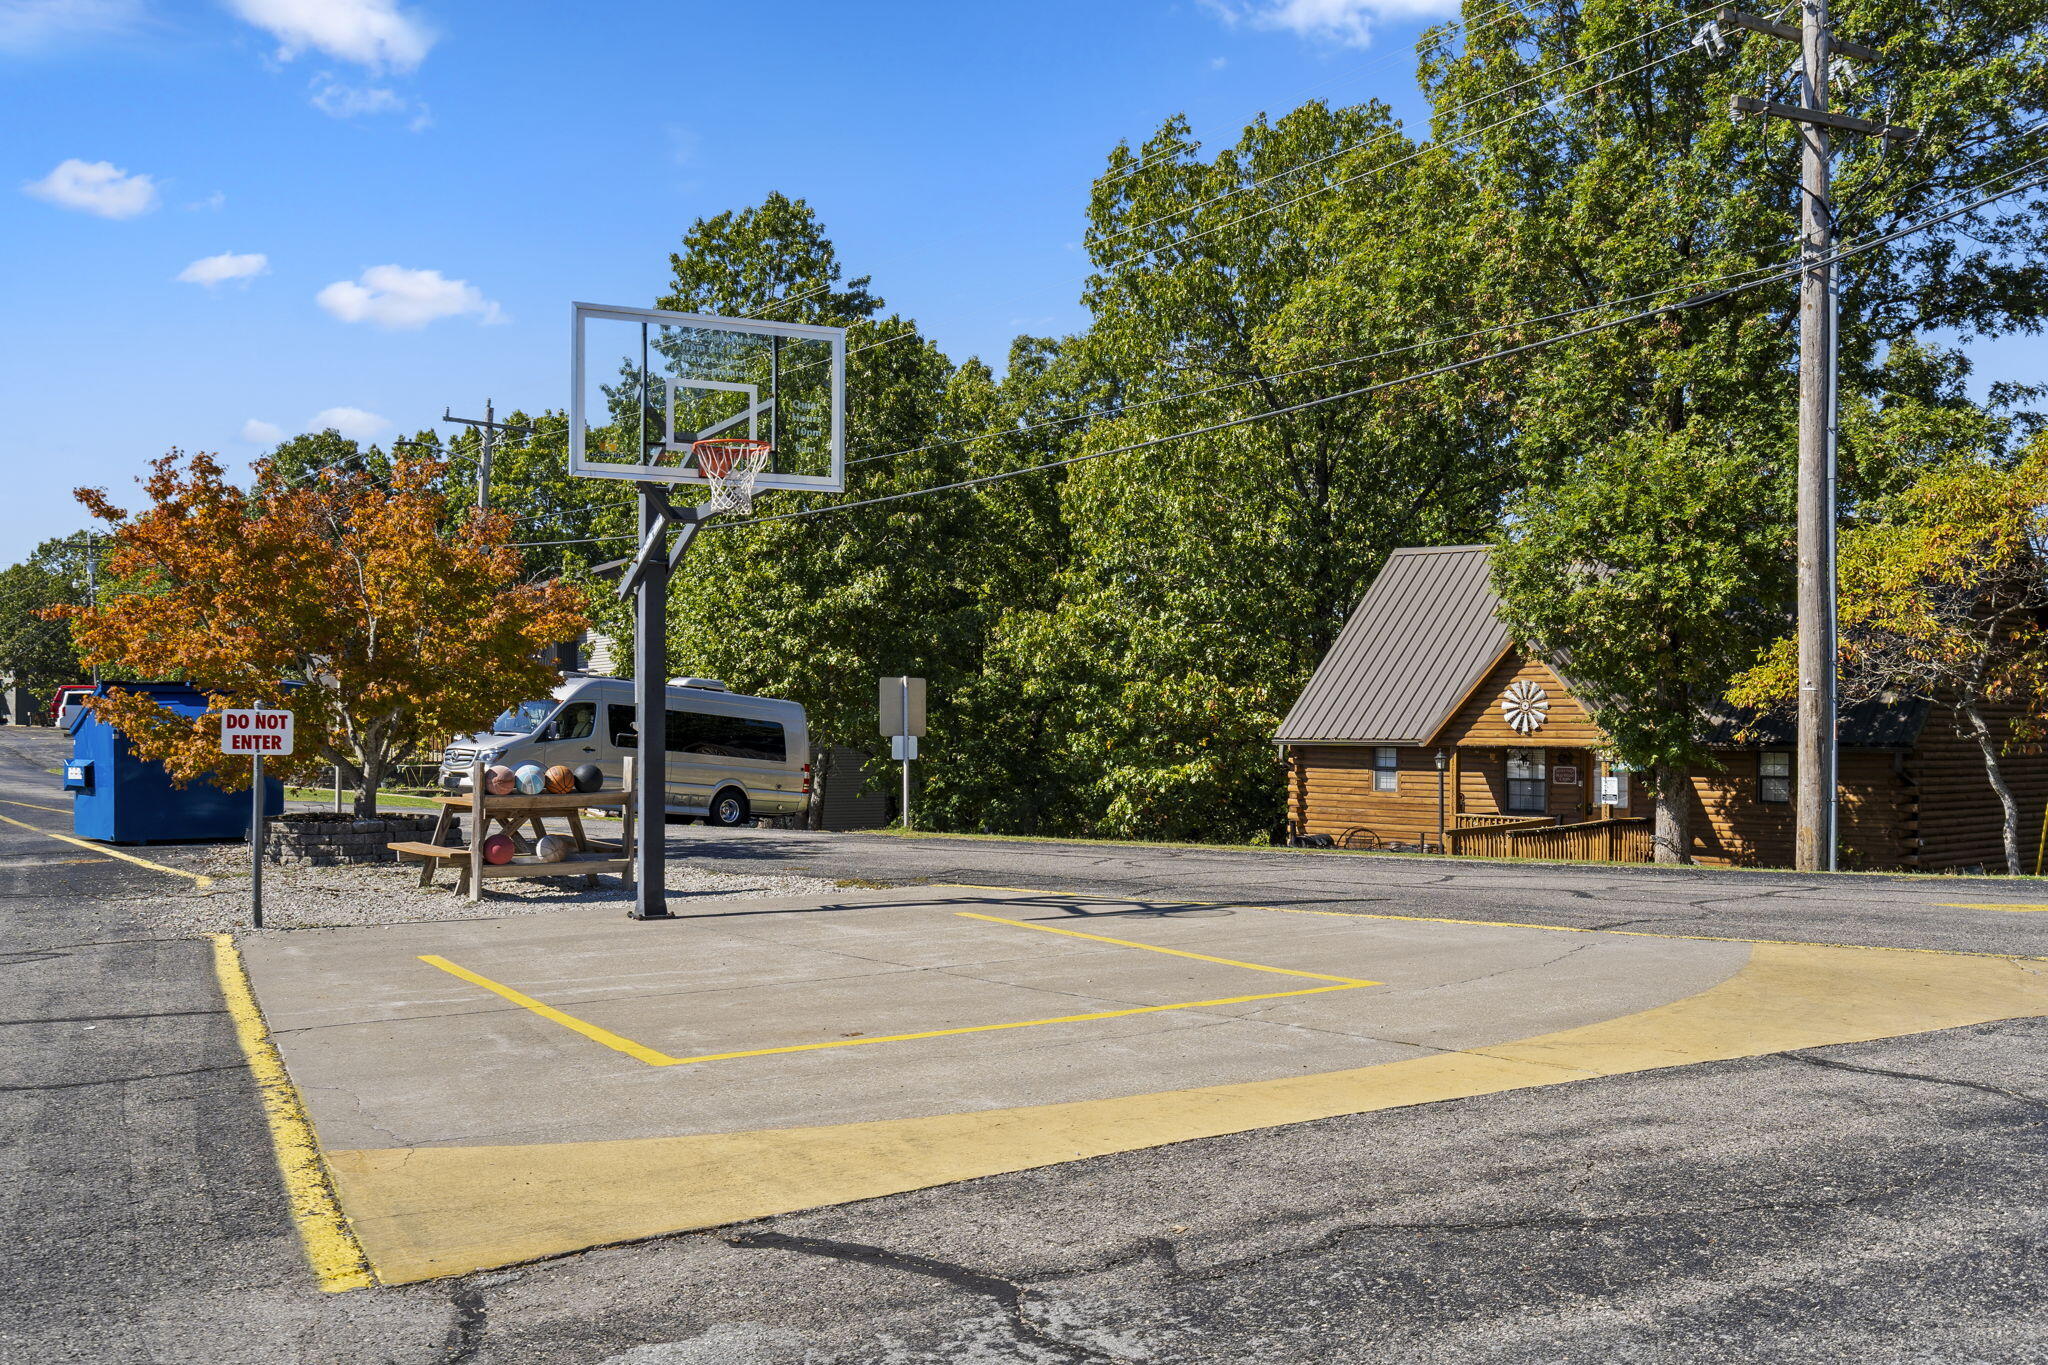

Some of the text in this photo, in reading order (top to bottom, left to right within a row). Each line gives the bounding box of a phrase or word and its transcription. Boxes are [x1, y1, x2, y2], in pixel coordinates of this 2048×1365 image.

[682, 342, 705, 352] from
[711, 366, 754, 379] premises
[792, 400, 821, 411] Quiet
[792, 413, 822, 423] Hours
[796, 427, 822, 438] 10pm
[795, 442, 816, 453] 8am
[226, 714, 288, 729] DO NOT
[232, 735, 282, 750] ENTER
